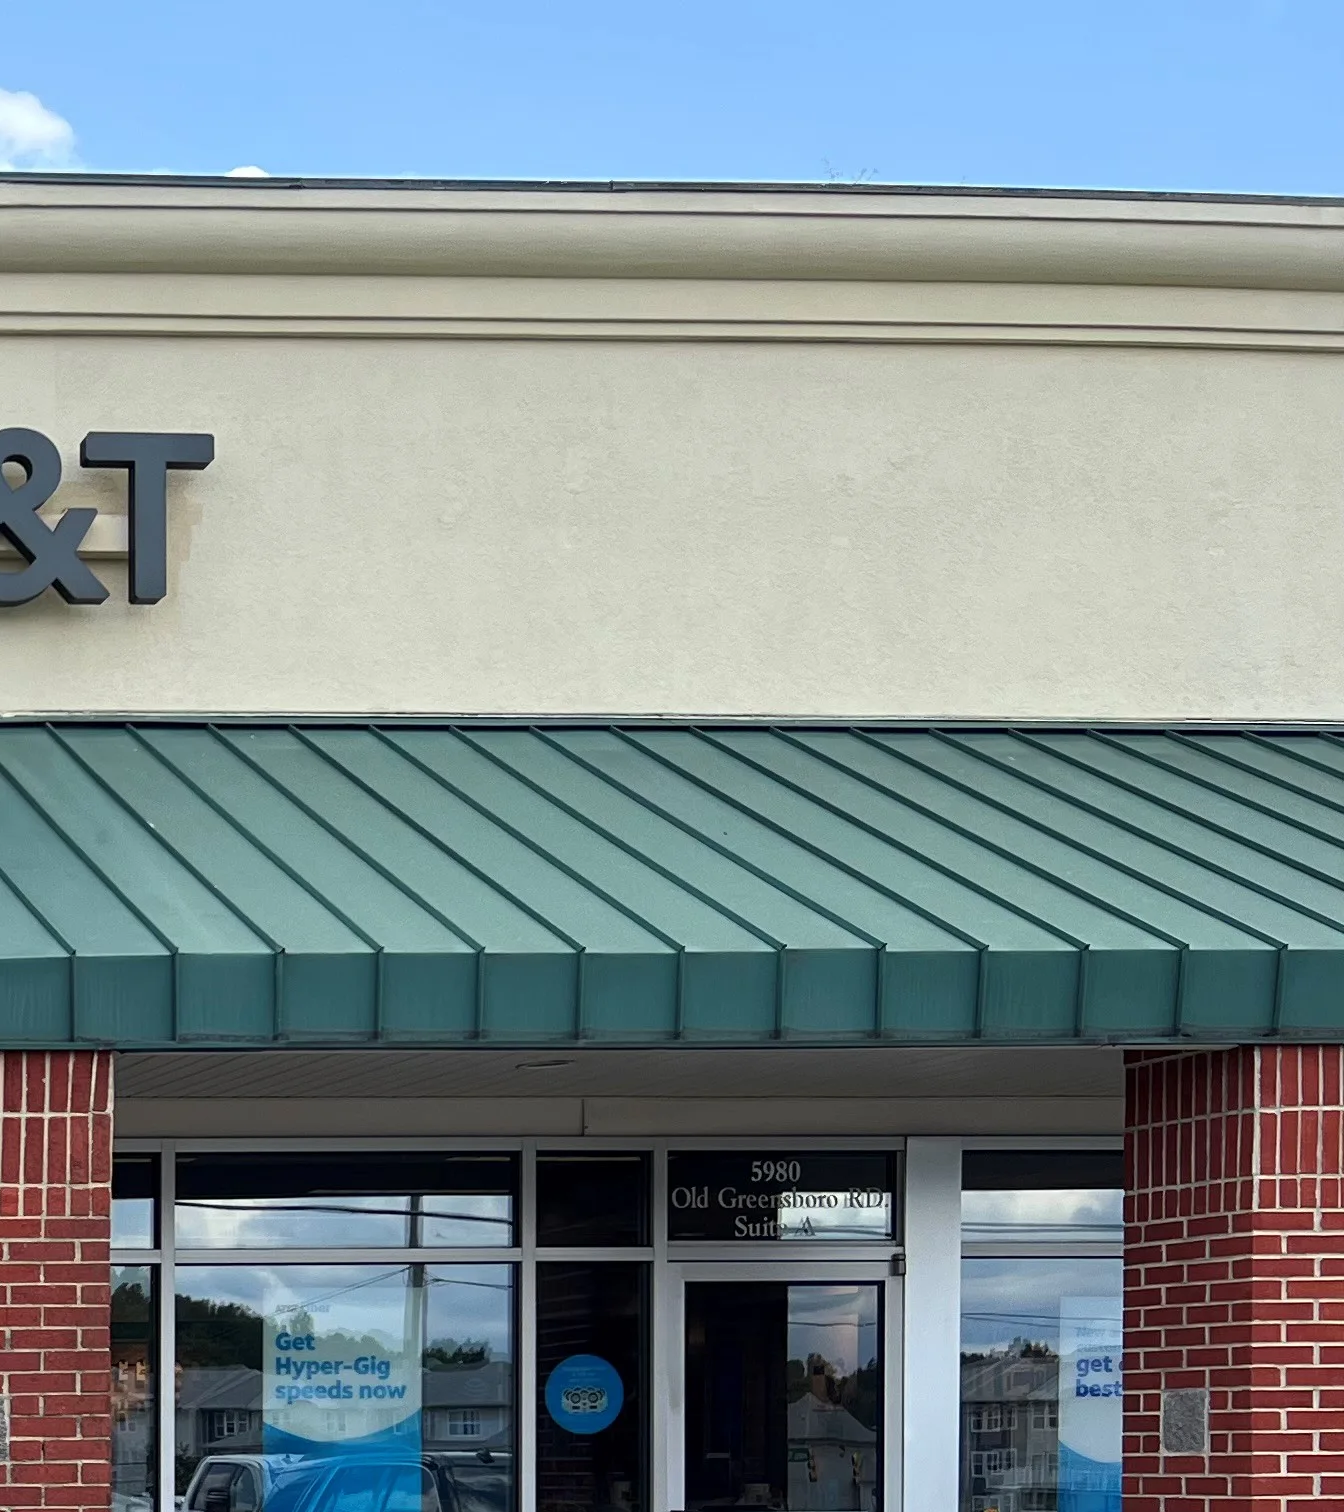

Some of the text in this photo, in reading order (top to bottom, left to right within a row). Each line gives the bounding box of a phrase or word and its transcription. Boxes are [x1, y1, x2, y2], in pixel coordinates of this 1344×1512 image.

[751, 1160, 801, 1182] 5980
[671, 1186, 709, 1209] Old
[718, 1186, 838, 1209] Greensboro
[275, 1332, 316, 1351] Get
[275, 1355, 391, 1380] Hyper-Gig
[1076, 1356, 1113, 1377] get
[275, 1380, 407, 1405] speeds now
[1076, 1378, 1123, 1398] best
